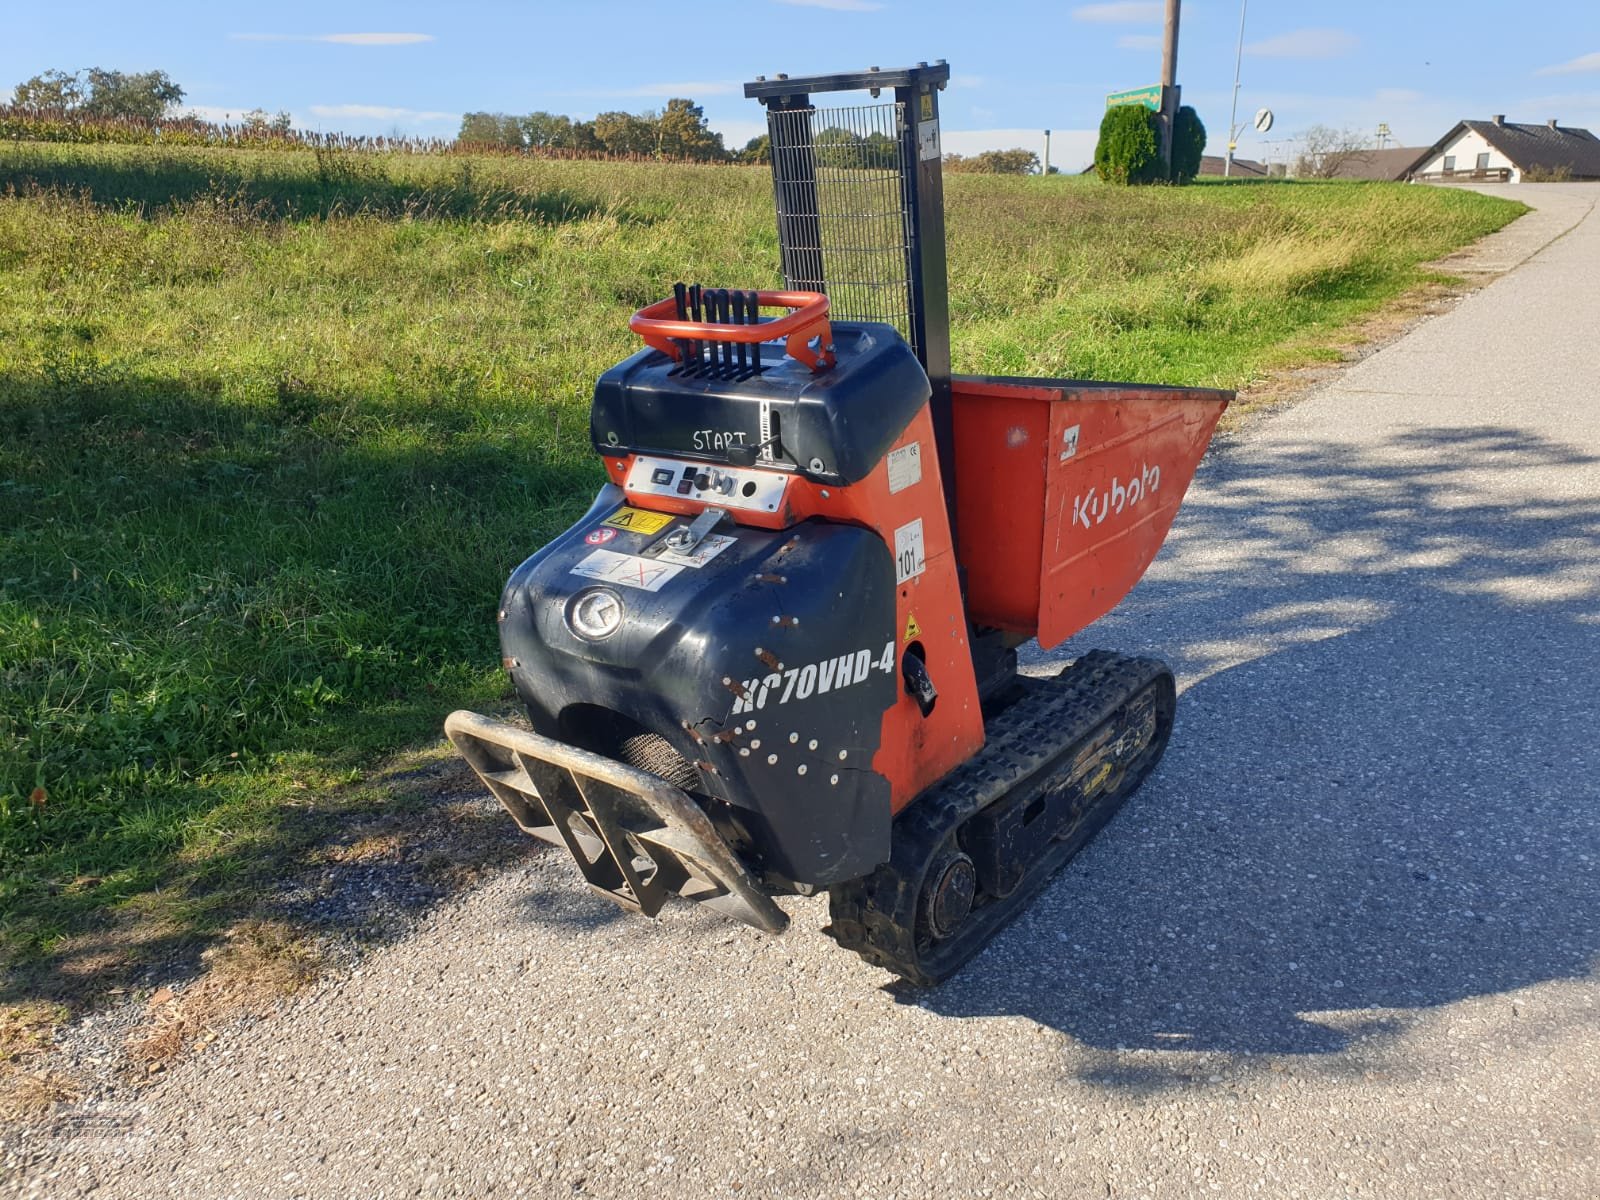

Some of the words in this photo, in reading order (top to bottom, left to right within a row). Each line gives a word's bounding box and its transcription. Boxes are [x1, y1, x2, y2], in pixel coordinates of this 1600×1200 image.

[693, 429, 747, 450] START
[1072, 462, 1161, 529] Kubota
[898, 546, 916, 578] 101
